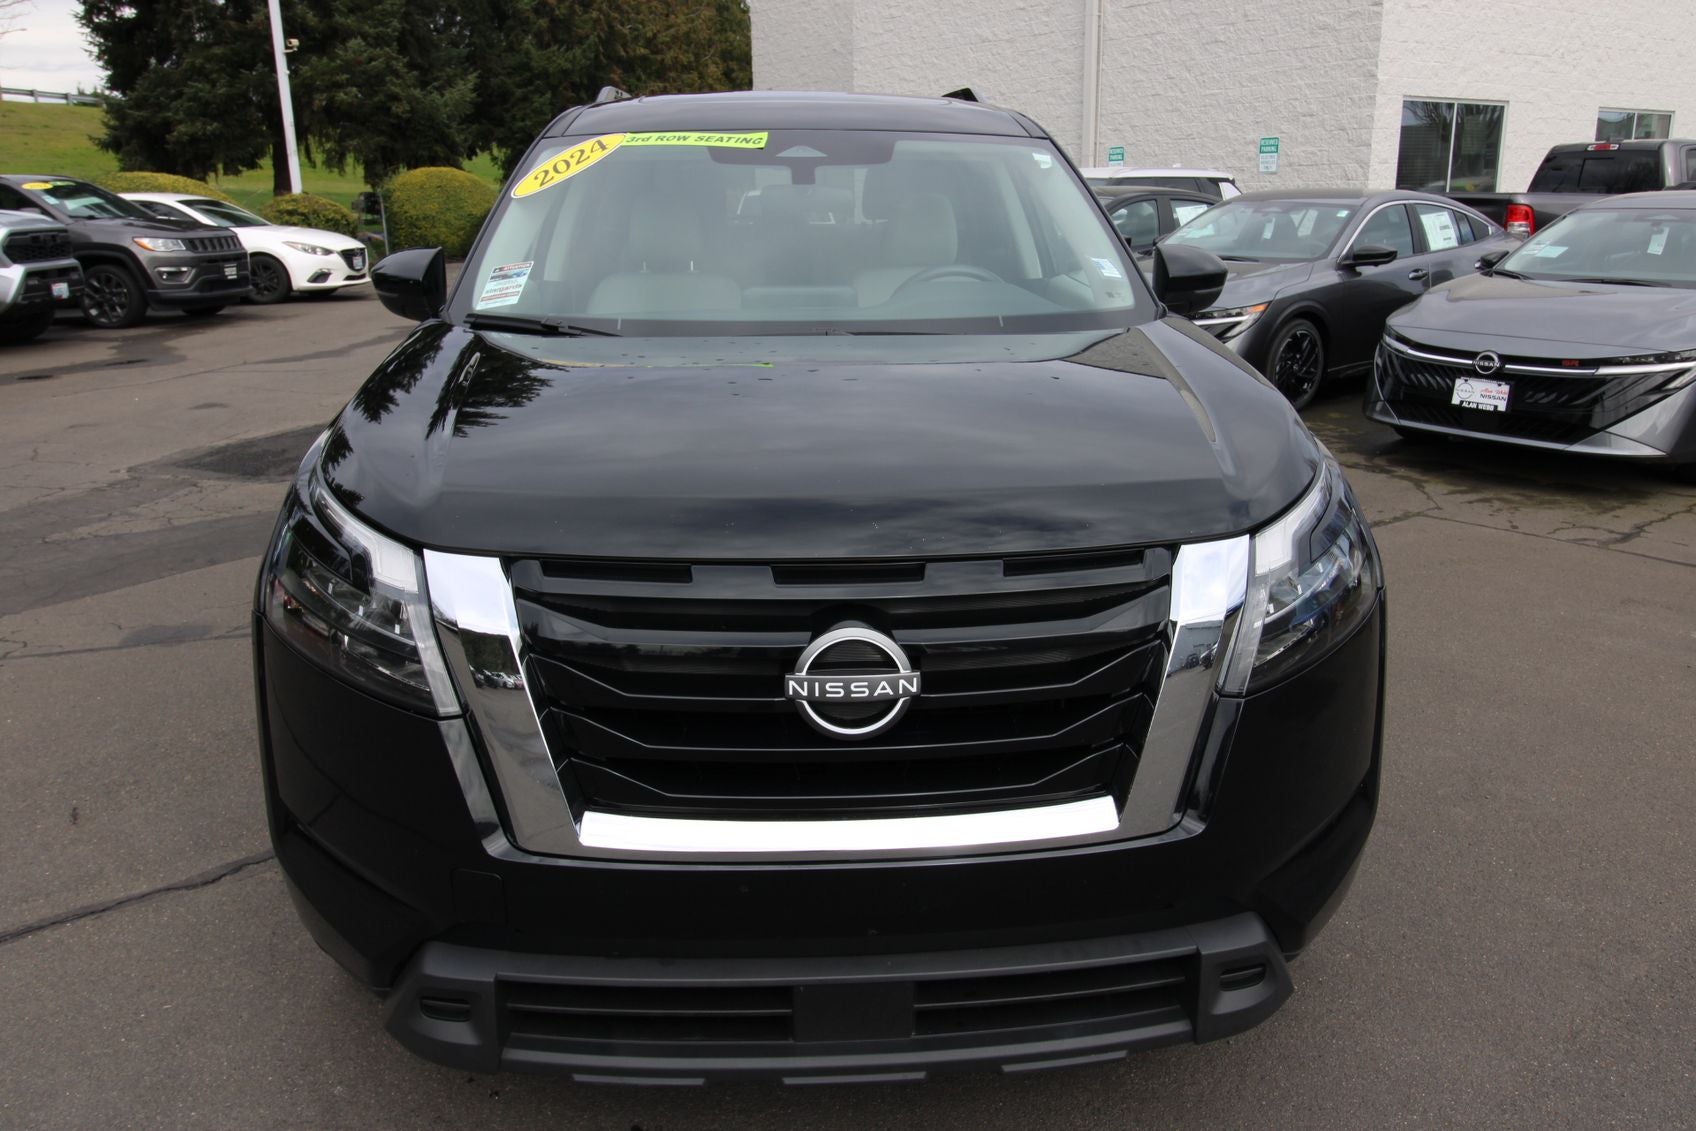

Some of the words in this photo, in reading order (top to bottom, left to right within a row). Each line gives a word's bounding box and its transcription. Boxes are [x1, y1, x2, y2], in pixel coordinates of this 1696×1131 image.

[625, 135, 652, 143] 3rd
[694, 135, 763, 145] SEATING
[534, 138, 610, 188] 2024
[1472, 360, 1500, 368] NISSAN
[1480, 394, 1506, 402] NISSAN
[788, 677, 918, 698] NISSAN
